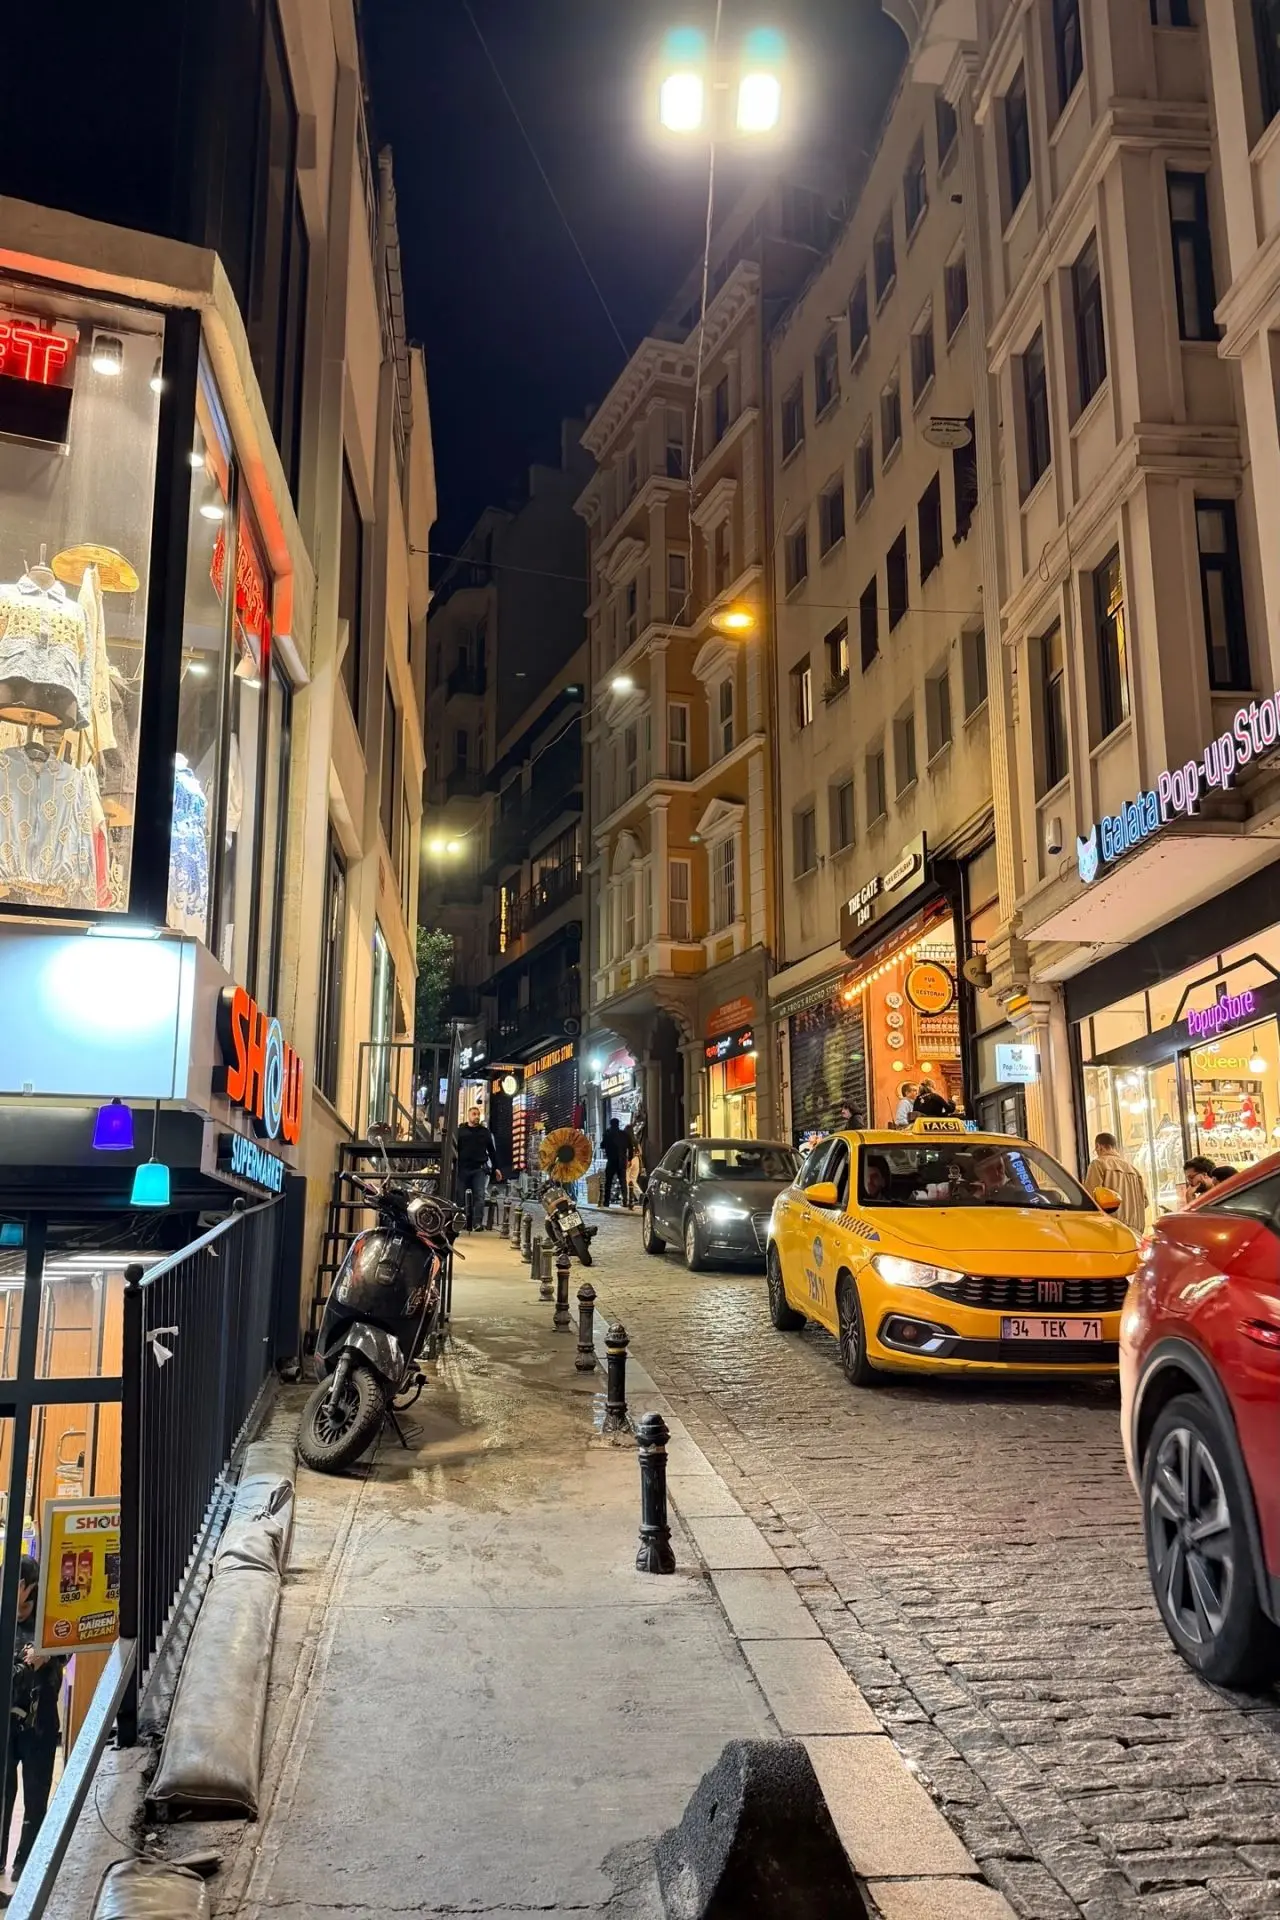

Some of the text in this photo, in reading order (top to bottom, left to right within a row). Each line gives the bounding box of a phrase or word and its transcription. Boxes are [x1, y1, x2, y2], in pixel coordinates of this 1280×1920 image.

[1100, 790, 1159, 862] Galata
[1158, 731, 1236, 822] Pop-up
[848, 877, 878, 916] THE GATE
[222, 985, 303, 1145] SHOW
[1194, 1051, 1248, 1071] Queen
[924, 1121, 959, 1130] TAKSI
[231, 1133, 284, 1193] SUPERMARKET
[1038, 1281, 1064, 1303] FIAT
[1012, 1320, 1029, 1337] 34
[1041, 1320, 1067, 1338] TEK
[1082, 1321, 1099, 1338] 71
